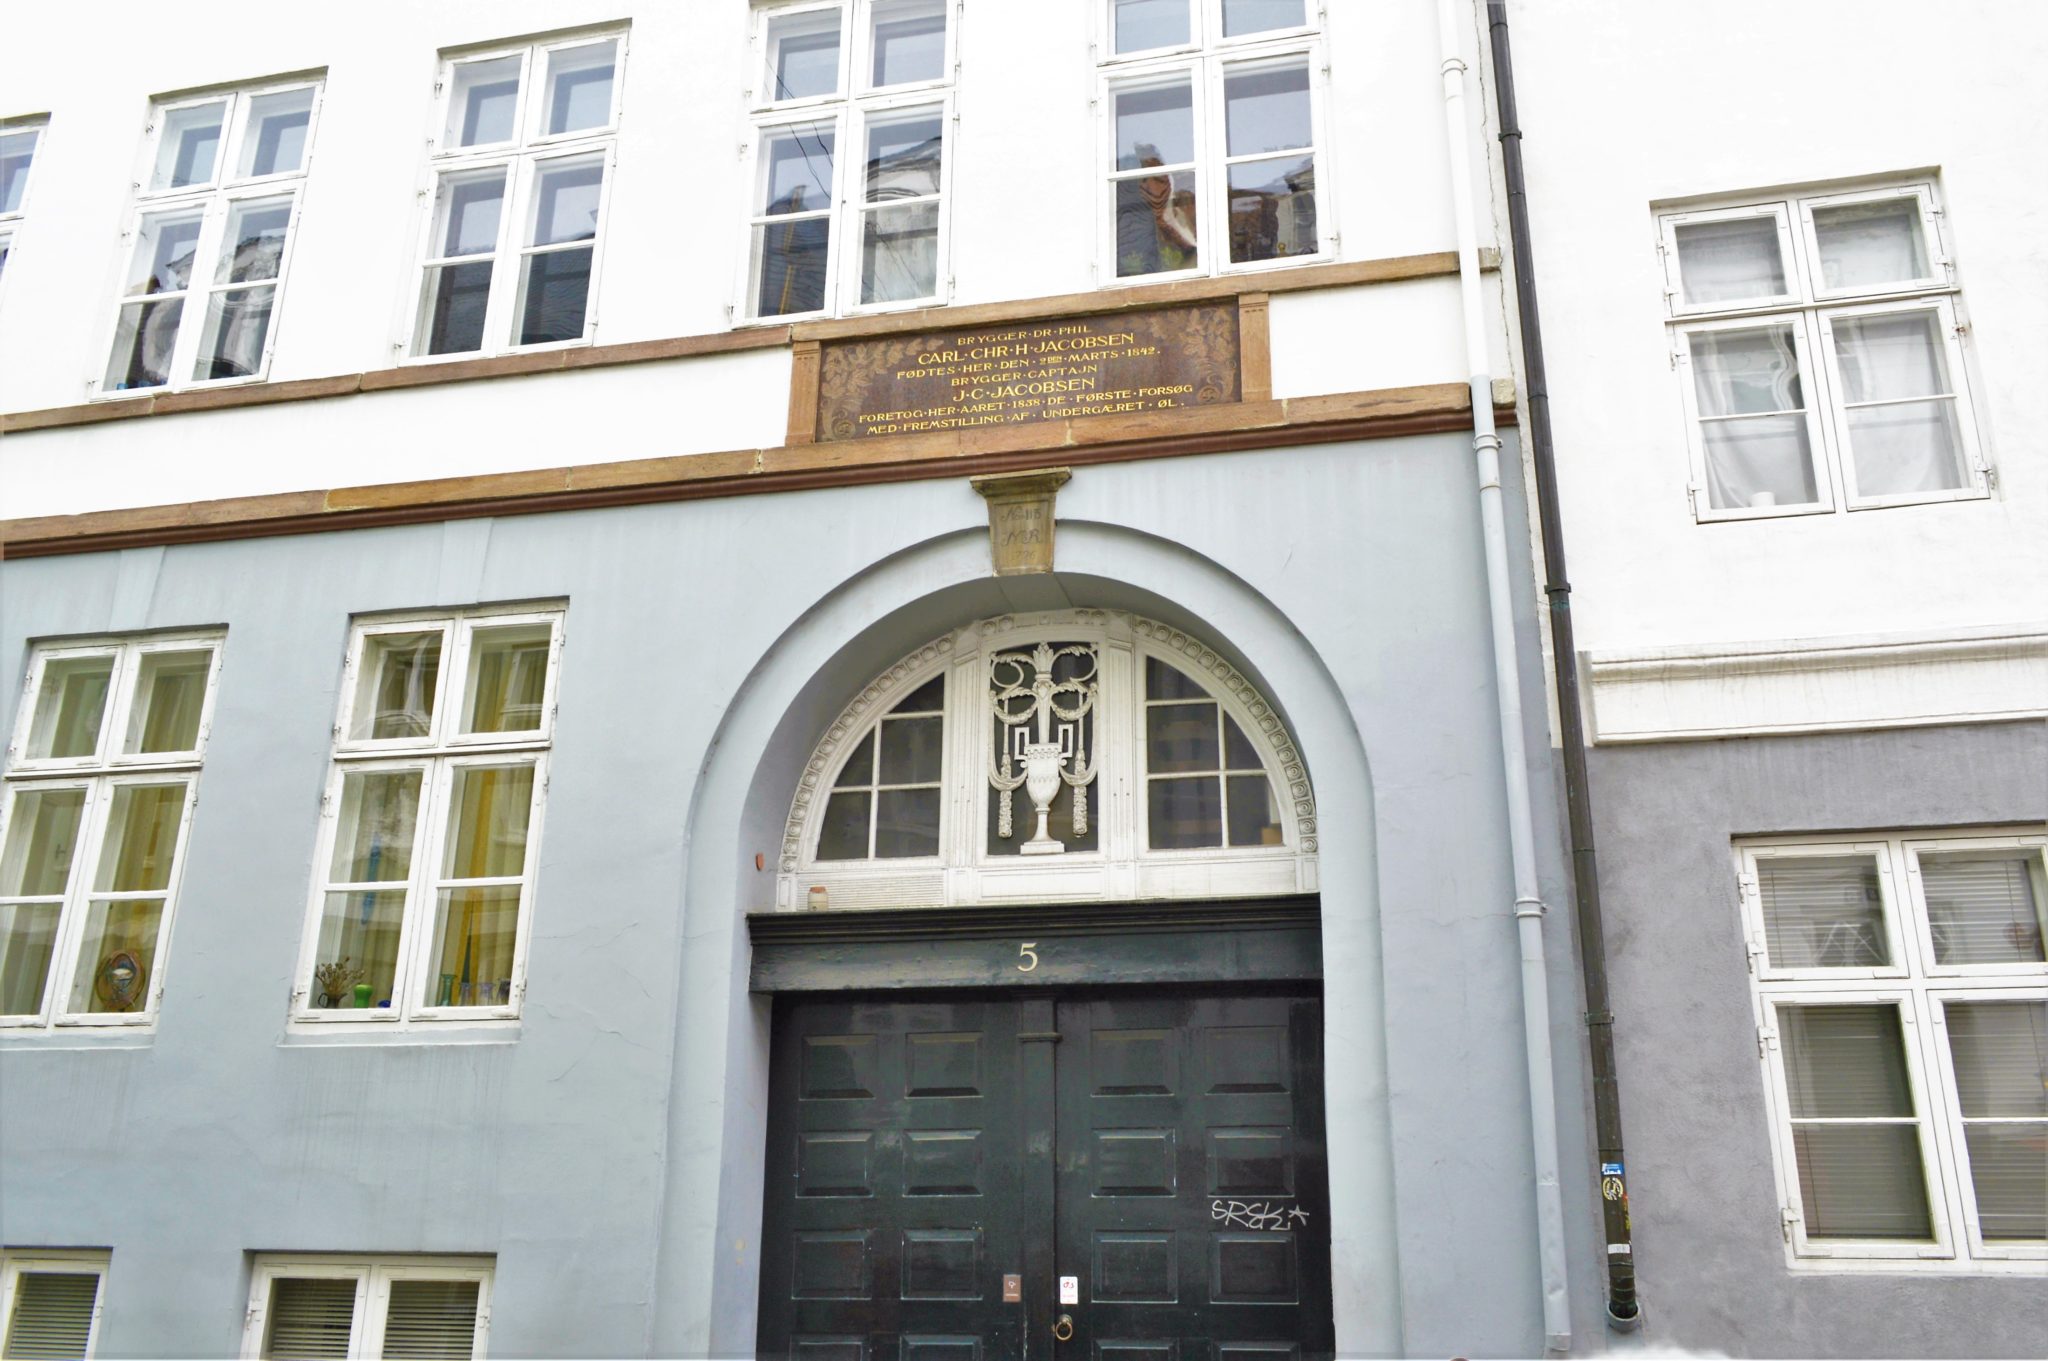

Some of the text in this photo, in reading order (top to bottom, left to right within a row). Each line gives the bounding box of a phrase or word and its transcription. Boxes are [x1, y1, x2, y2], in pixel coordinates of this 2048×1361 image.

[958, 325, 1092, 346] BRYGGER DR PHIL
[918, 333, 1134, 365] CARL CHR H JACOBSEN
[897, 367, 956, 380] FØDTES
[963, 362, 992, 373] HER
[1000, 359, 1029, 369] DEN
[1068, 350, 1119, 362] MARTS
[951, 364, 1097, 386] BRYGGER CAPTAJN
[990, 379, 1095, 399] JACOBSEN
[859, 410, 923, 423] FORETOG
[928, 407, 956, 417] HER
[961, 402, 1005, 414] AARET
[1047, 396, 1066, 406] DE
[1076, 390, 1131, 403] FØRSTE
[1139, 384, 1193, 397] FORSØG
[867, 424, 897, 435] MED
[903, 415, 1004, 432] FREMSTILLING
[1011, 412, 1030, 421] AF
[1017, 942, 1038, 972] 5
